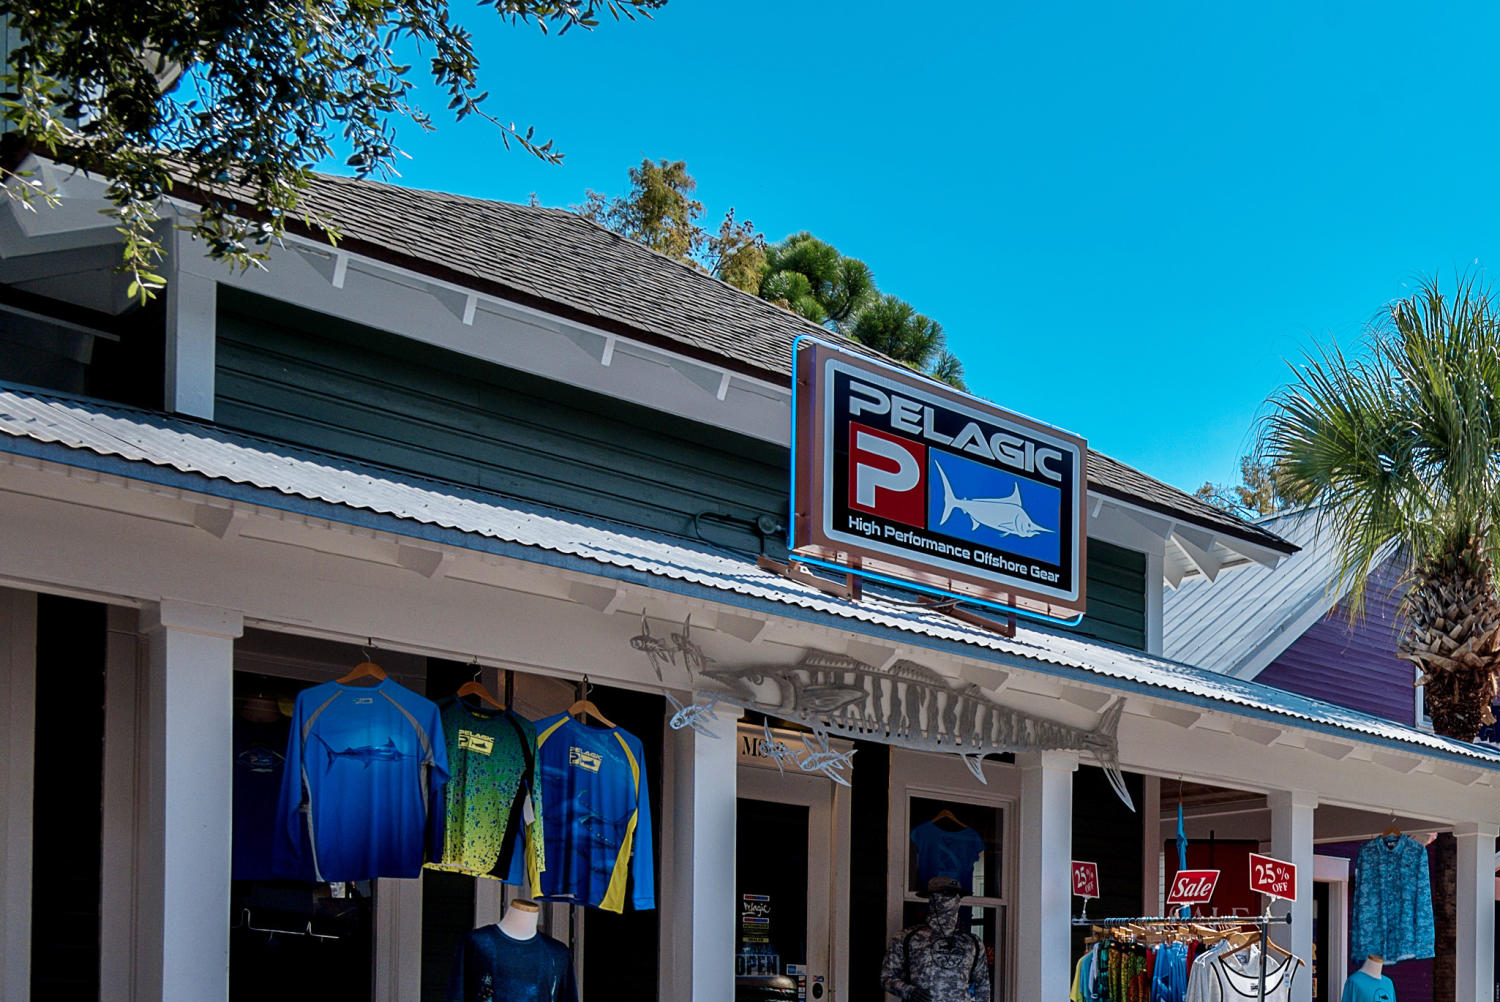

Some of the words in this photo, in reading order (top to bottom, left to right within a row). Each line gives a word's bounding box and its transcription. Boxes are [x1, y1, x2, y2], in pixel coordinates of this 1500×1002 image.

[848, 379, 1062, 482] PELAGIC
[848, 515, 881, 537] High
[884, 525, 971, 560] Performance
[973, 550, 1028, 577] Offshore
[1030, 565, 1060, 583] Gear
[1255, 863, 1290, 885] 25%
[1085, 882, 1094, 893] OFF
[1172, 877, 1212, 898] Sale
[1272, 882, 1288, 893] OFF
[736, 954, 777, 976] OPEN
